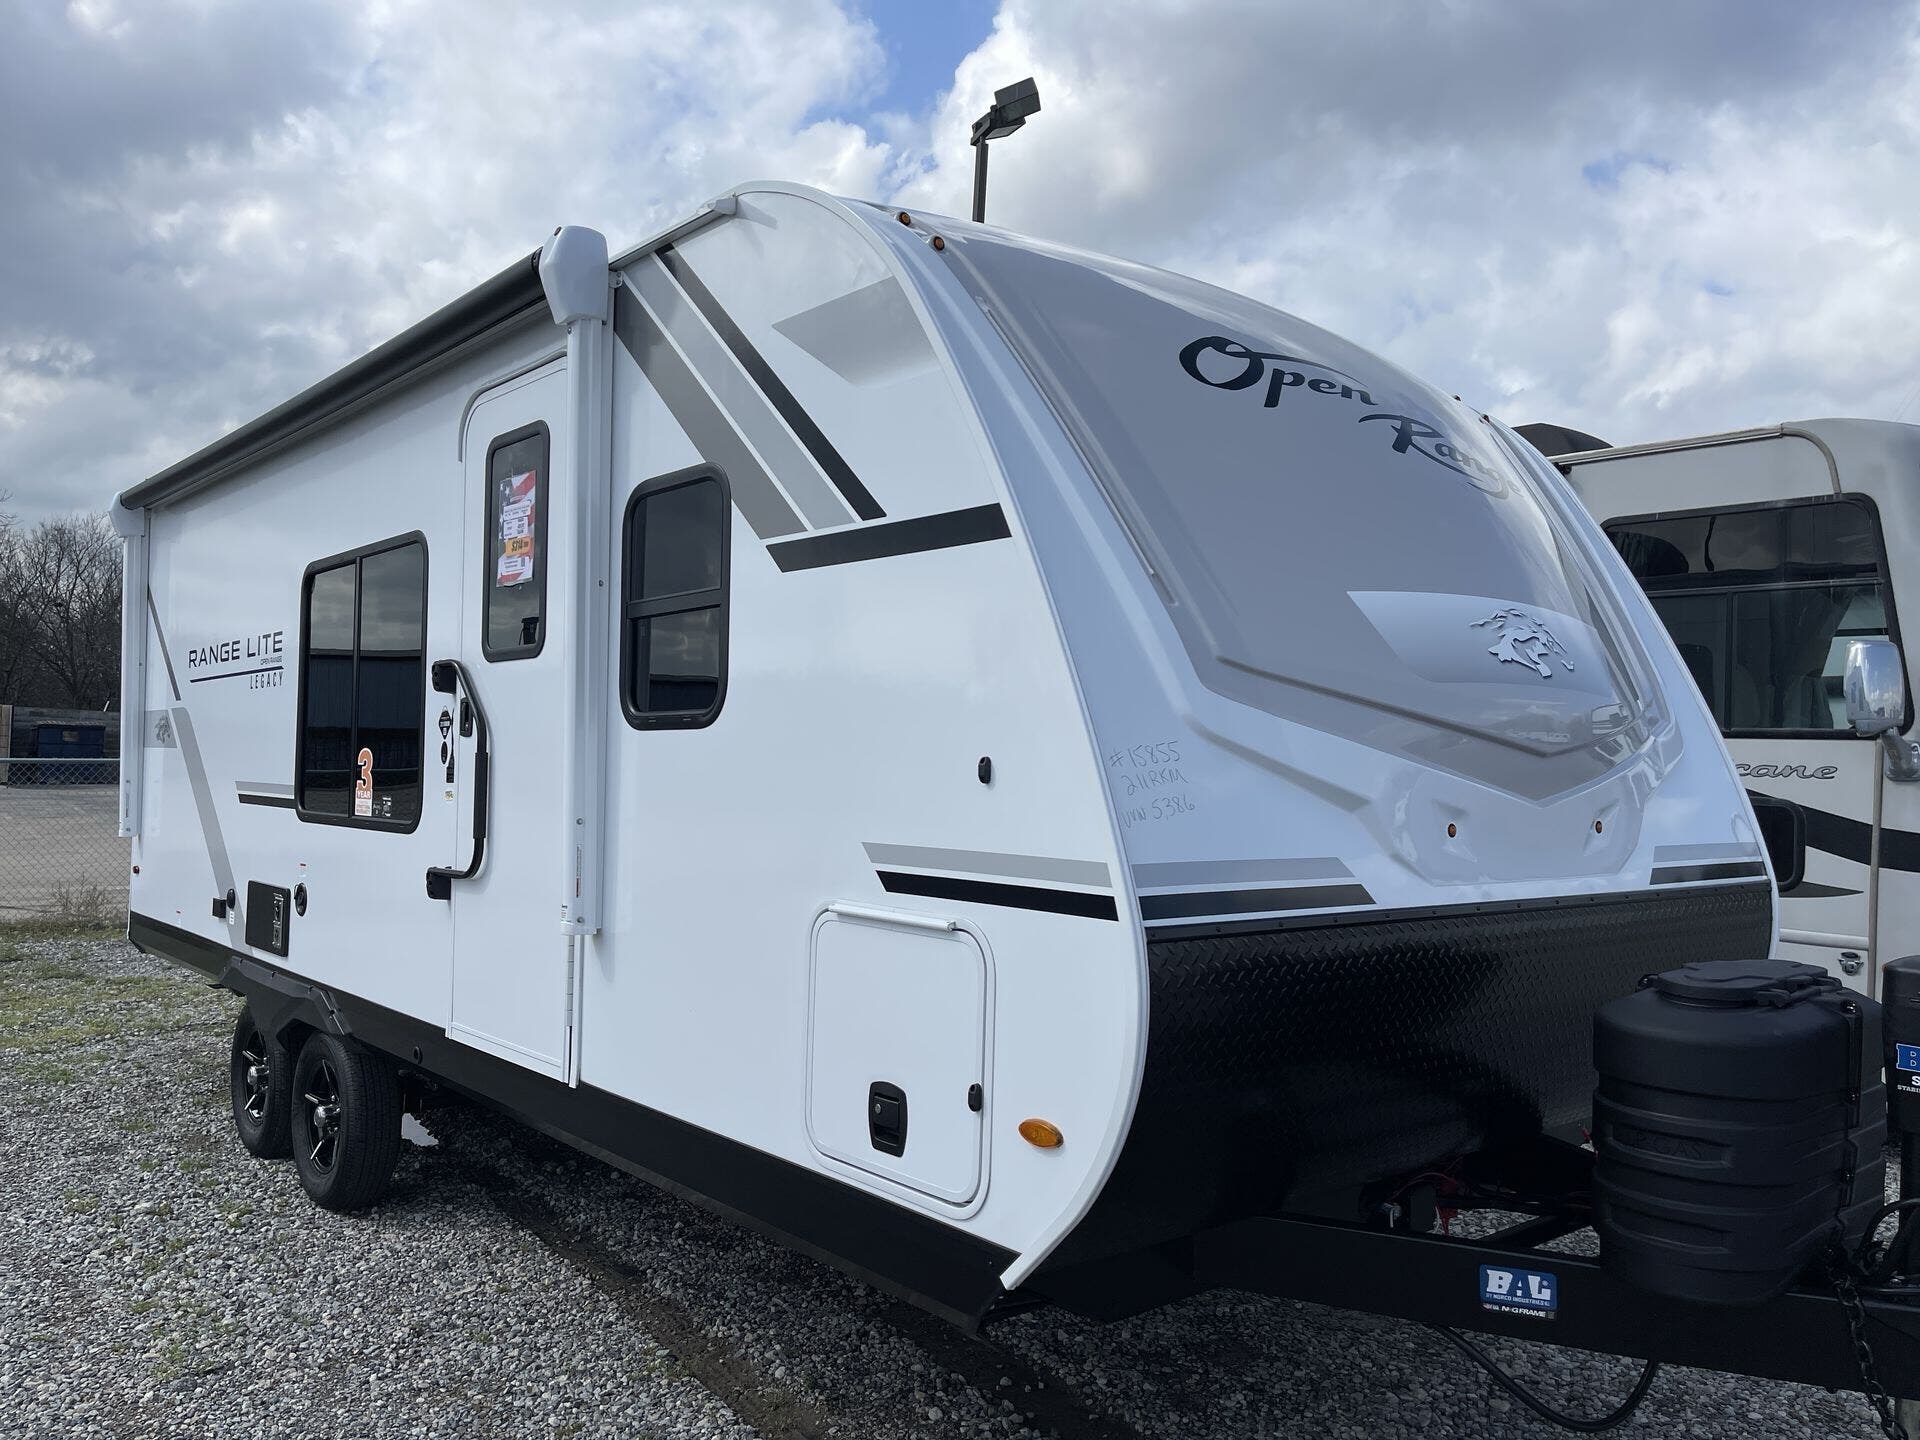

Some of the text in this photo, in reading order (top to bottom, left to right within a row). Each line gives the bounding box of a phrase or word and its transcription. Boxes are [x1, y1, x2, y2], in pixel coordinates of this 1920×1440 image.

[1179, 335, 1379, 408] Open
[188, 631, 283, 668] RANGE LITE
[250, 671, 283, 689] LEGACY
[357, 747, 373, 790] 3
[357, 790, 371, 799] YEAR
[1151, 794, 1196, 819] 5386
[1486, 1269, 1551, 1300] BAL
